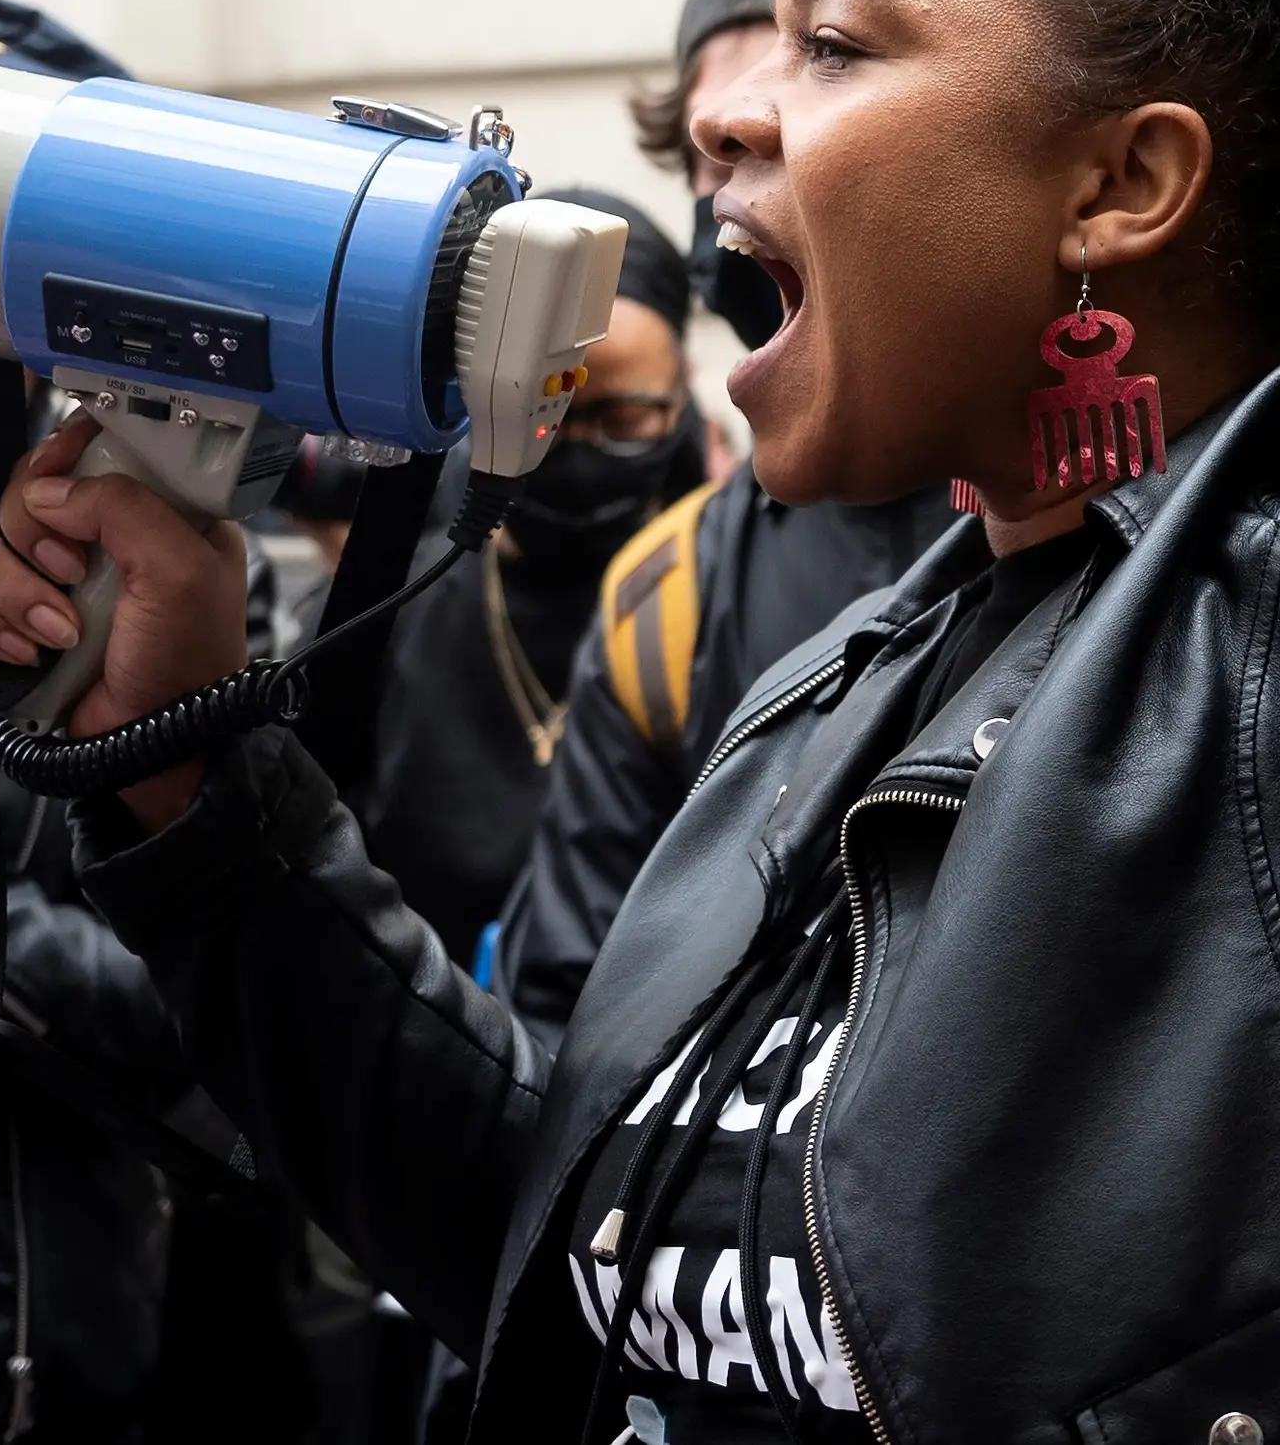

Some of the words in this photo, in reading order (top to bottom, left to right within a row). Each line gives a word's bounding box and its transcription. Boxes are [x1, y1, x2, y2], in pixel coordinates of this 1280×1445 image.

[124, 353, 147, 366] USB
[106, 378, 146, 396] USB/SD
[169, 395, 190, 407] MIC
